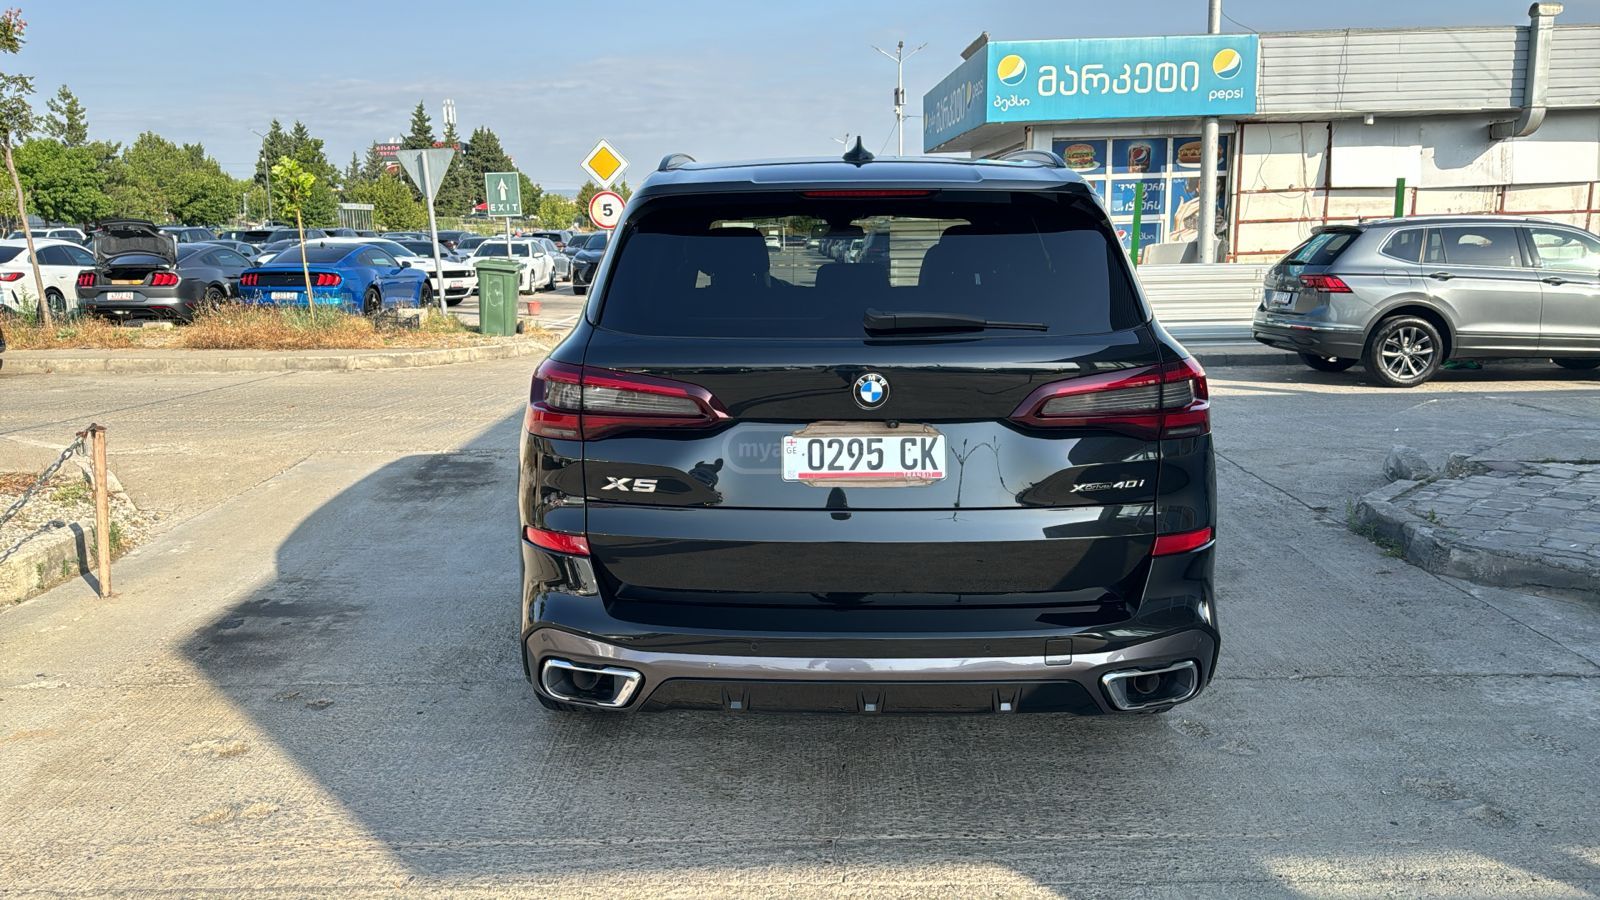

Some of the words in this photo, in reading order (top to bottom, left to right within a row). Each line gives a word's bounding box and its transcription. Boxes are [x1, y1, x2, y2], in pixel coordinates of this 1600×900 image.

[1037, 61, 1200, 97] მარკეტი
[1208, 87, 1244, 102] pepsi
[993, 94, 1031, 112] პეპსი
[490, 203, 519, 212] EXIT
[602, 203, 614, 217] 5
[857, 374, 887, 387] BMW
[786, 446, 797, 455] GE
[807, 437, 884, 472] 0295
[900, 437, 939, 471] CK
[600, 476, 659, 493] X5
